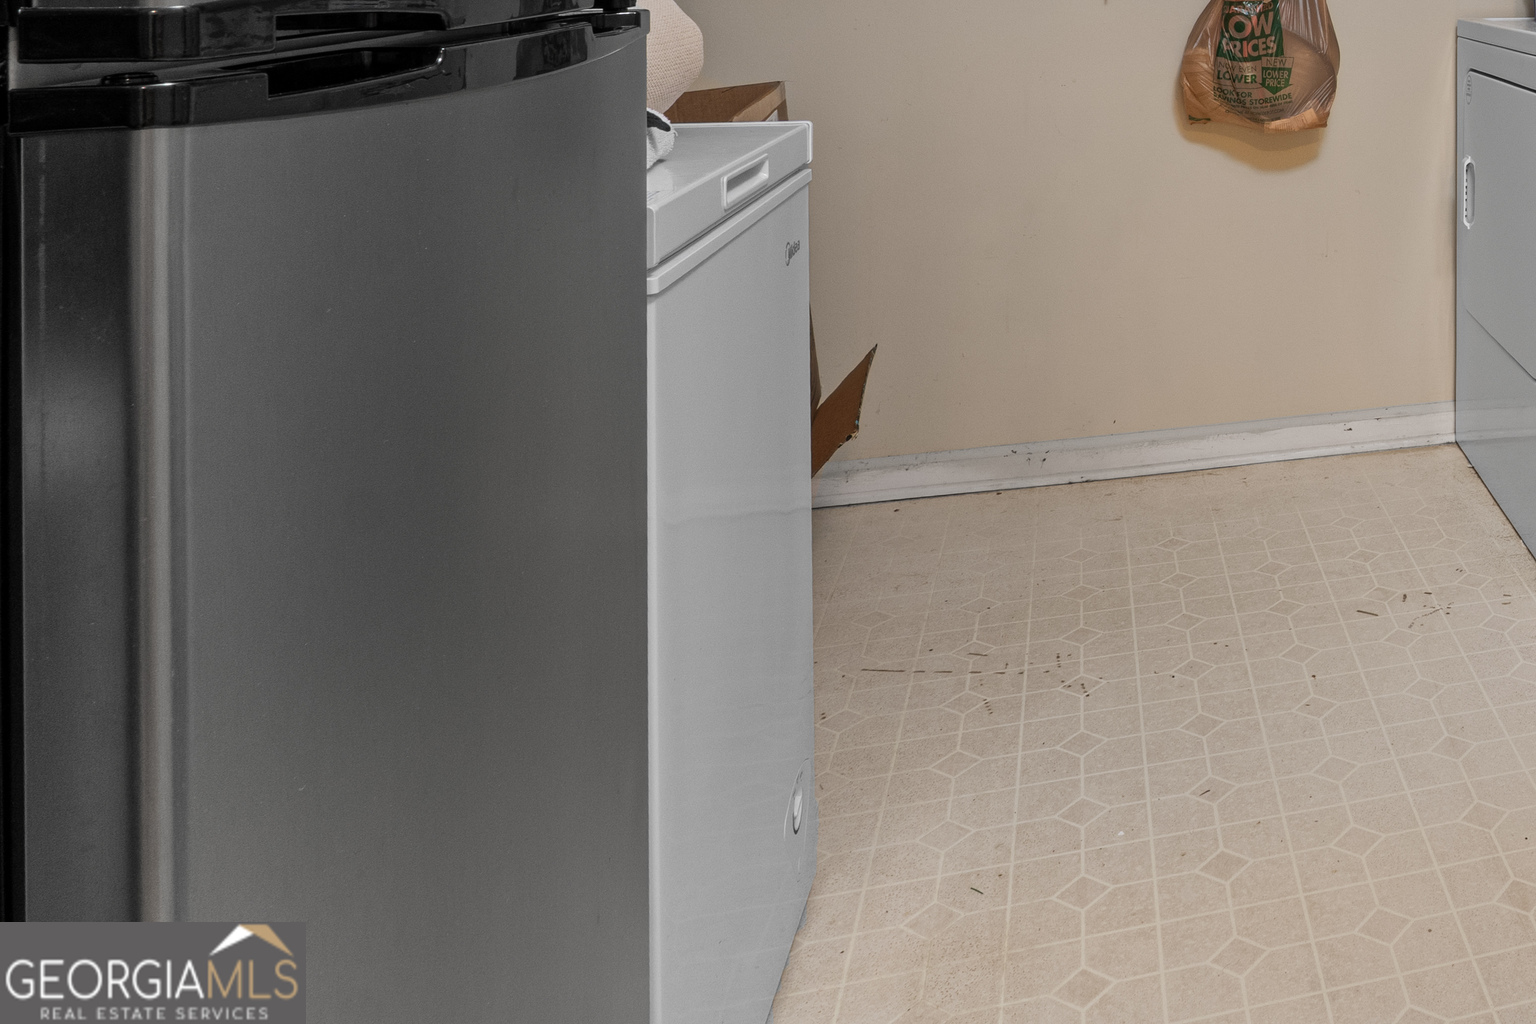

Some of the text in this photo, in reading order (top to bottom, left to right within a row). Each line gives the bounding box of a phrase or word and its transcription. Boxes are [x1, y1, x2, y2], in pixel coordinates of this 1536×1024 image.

[1222, 36, 1276, 58] PRICES
[1217, 70, 1257, 84] LOWER
[1263, 70, 1288, 79] LOWER
[1213, 86, 1234, 96] LOOK
[1250, 93, 1292, 105] STOREWIDE
